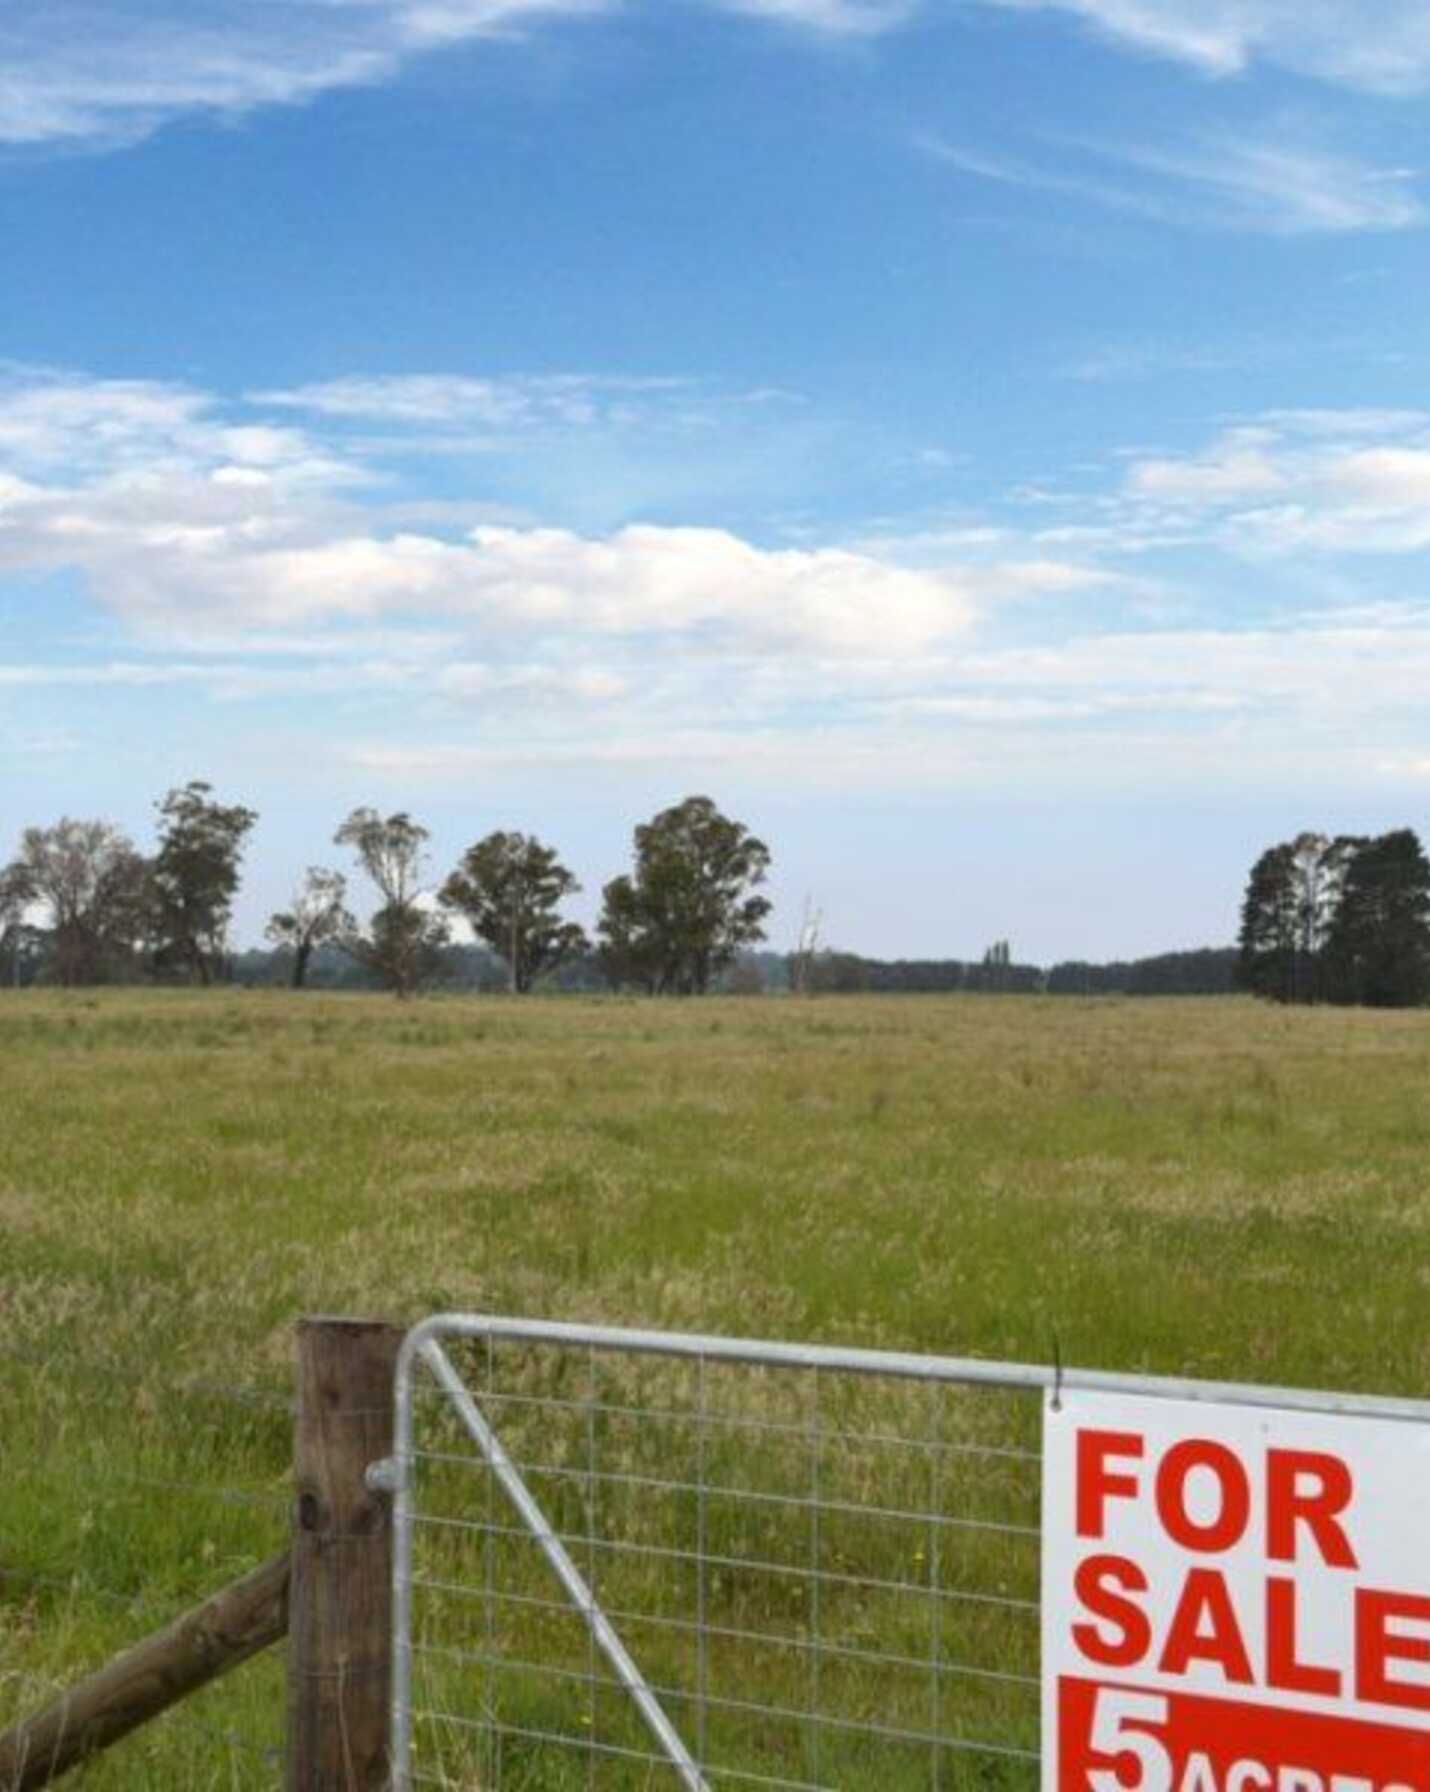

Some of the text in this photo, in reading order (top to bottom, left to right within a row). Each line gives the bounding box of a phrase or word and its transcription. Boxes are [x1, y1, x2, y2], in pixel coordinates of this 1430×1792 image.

[1076, 1429, 1360, 1570] FOR
[1071, 1554, 1430, 1712] SALE
[1085, 1687, 1172, 1792] 5
